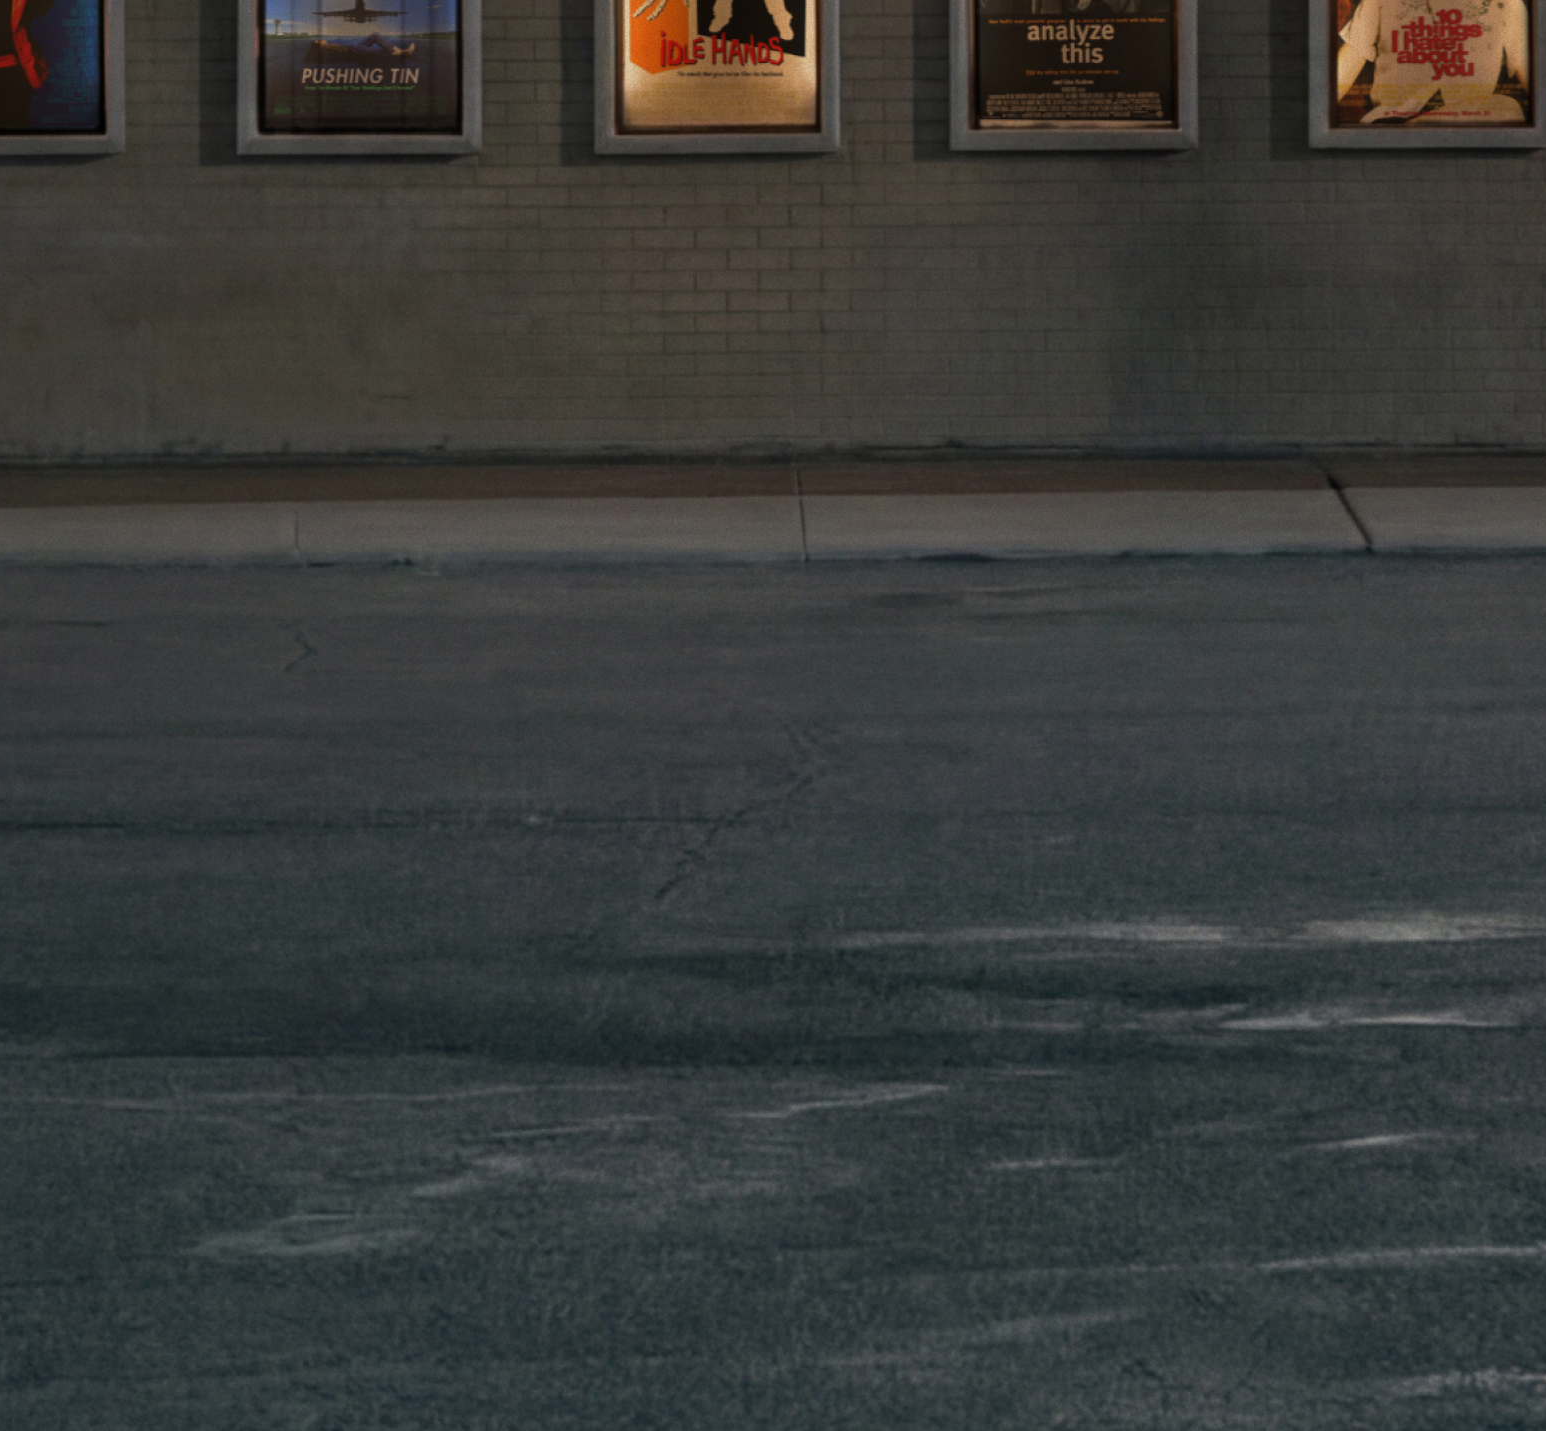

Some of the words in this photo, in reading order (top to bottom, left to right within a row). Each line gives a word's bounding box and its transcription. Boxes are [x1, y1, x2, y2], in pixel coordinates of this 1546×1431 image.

[1436, 9, 1462, 25] 10
[1026, 18, 1115, 46] analyze
[1401, 16, 1482, 41] things
[711, 31, 785, 66] HANDS
[1404, 31, 1454, 51] hate
[1060, 42, 1104, 64] this
[1397, 44, 1469, 64] about
[301, 68, 384, 84] PUSHING
[390, 68, 420, 84] TIN
[1432, 63, 1474, 81] you
